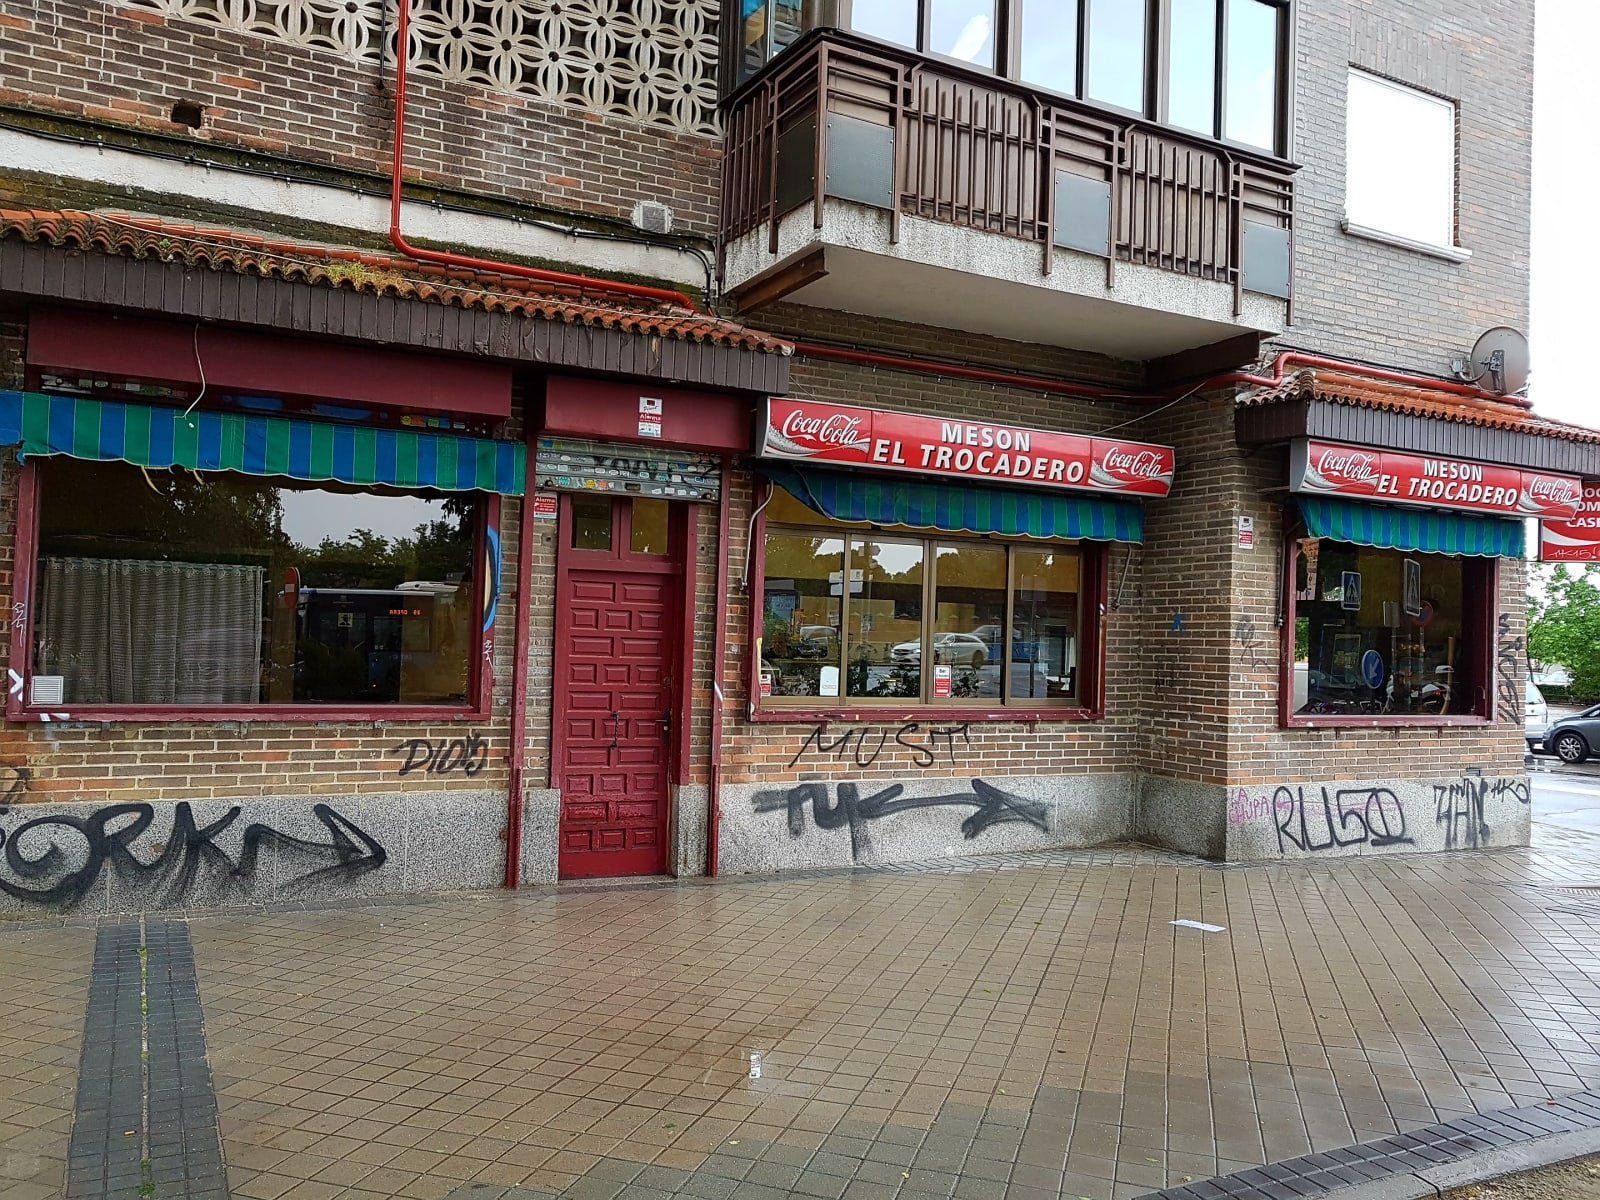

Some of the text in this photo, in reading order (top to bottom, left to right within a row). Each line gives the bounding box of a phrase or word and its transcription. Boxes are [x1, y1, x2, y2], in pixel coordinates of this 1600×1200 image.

[941, 422, 1031, 452] MESON
[873, 439, 1085, 483] EL TROCADERO
[1424, 459, 1483, 482] MESON
[1377, 474, 1518, 506] EL TROCADERO
